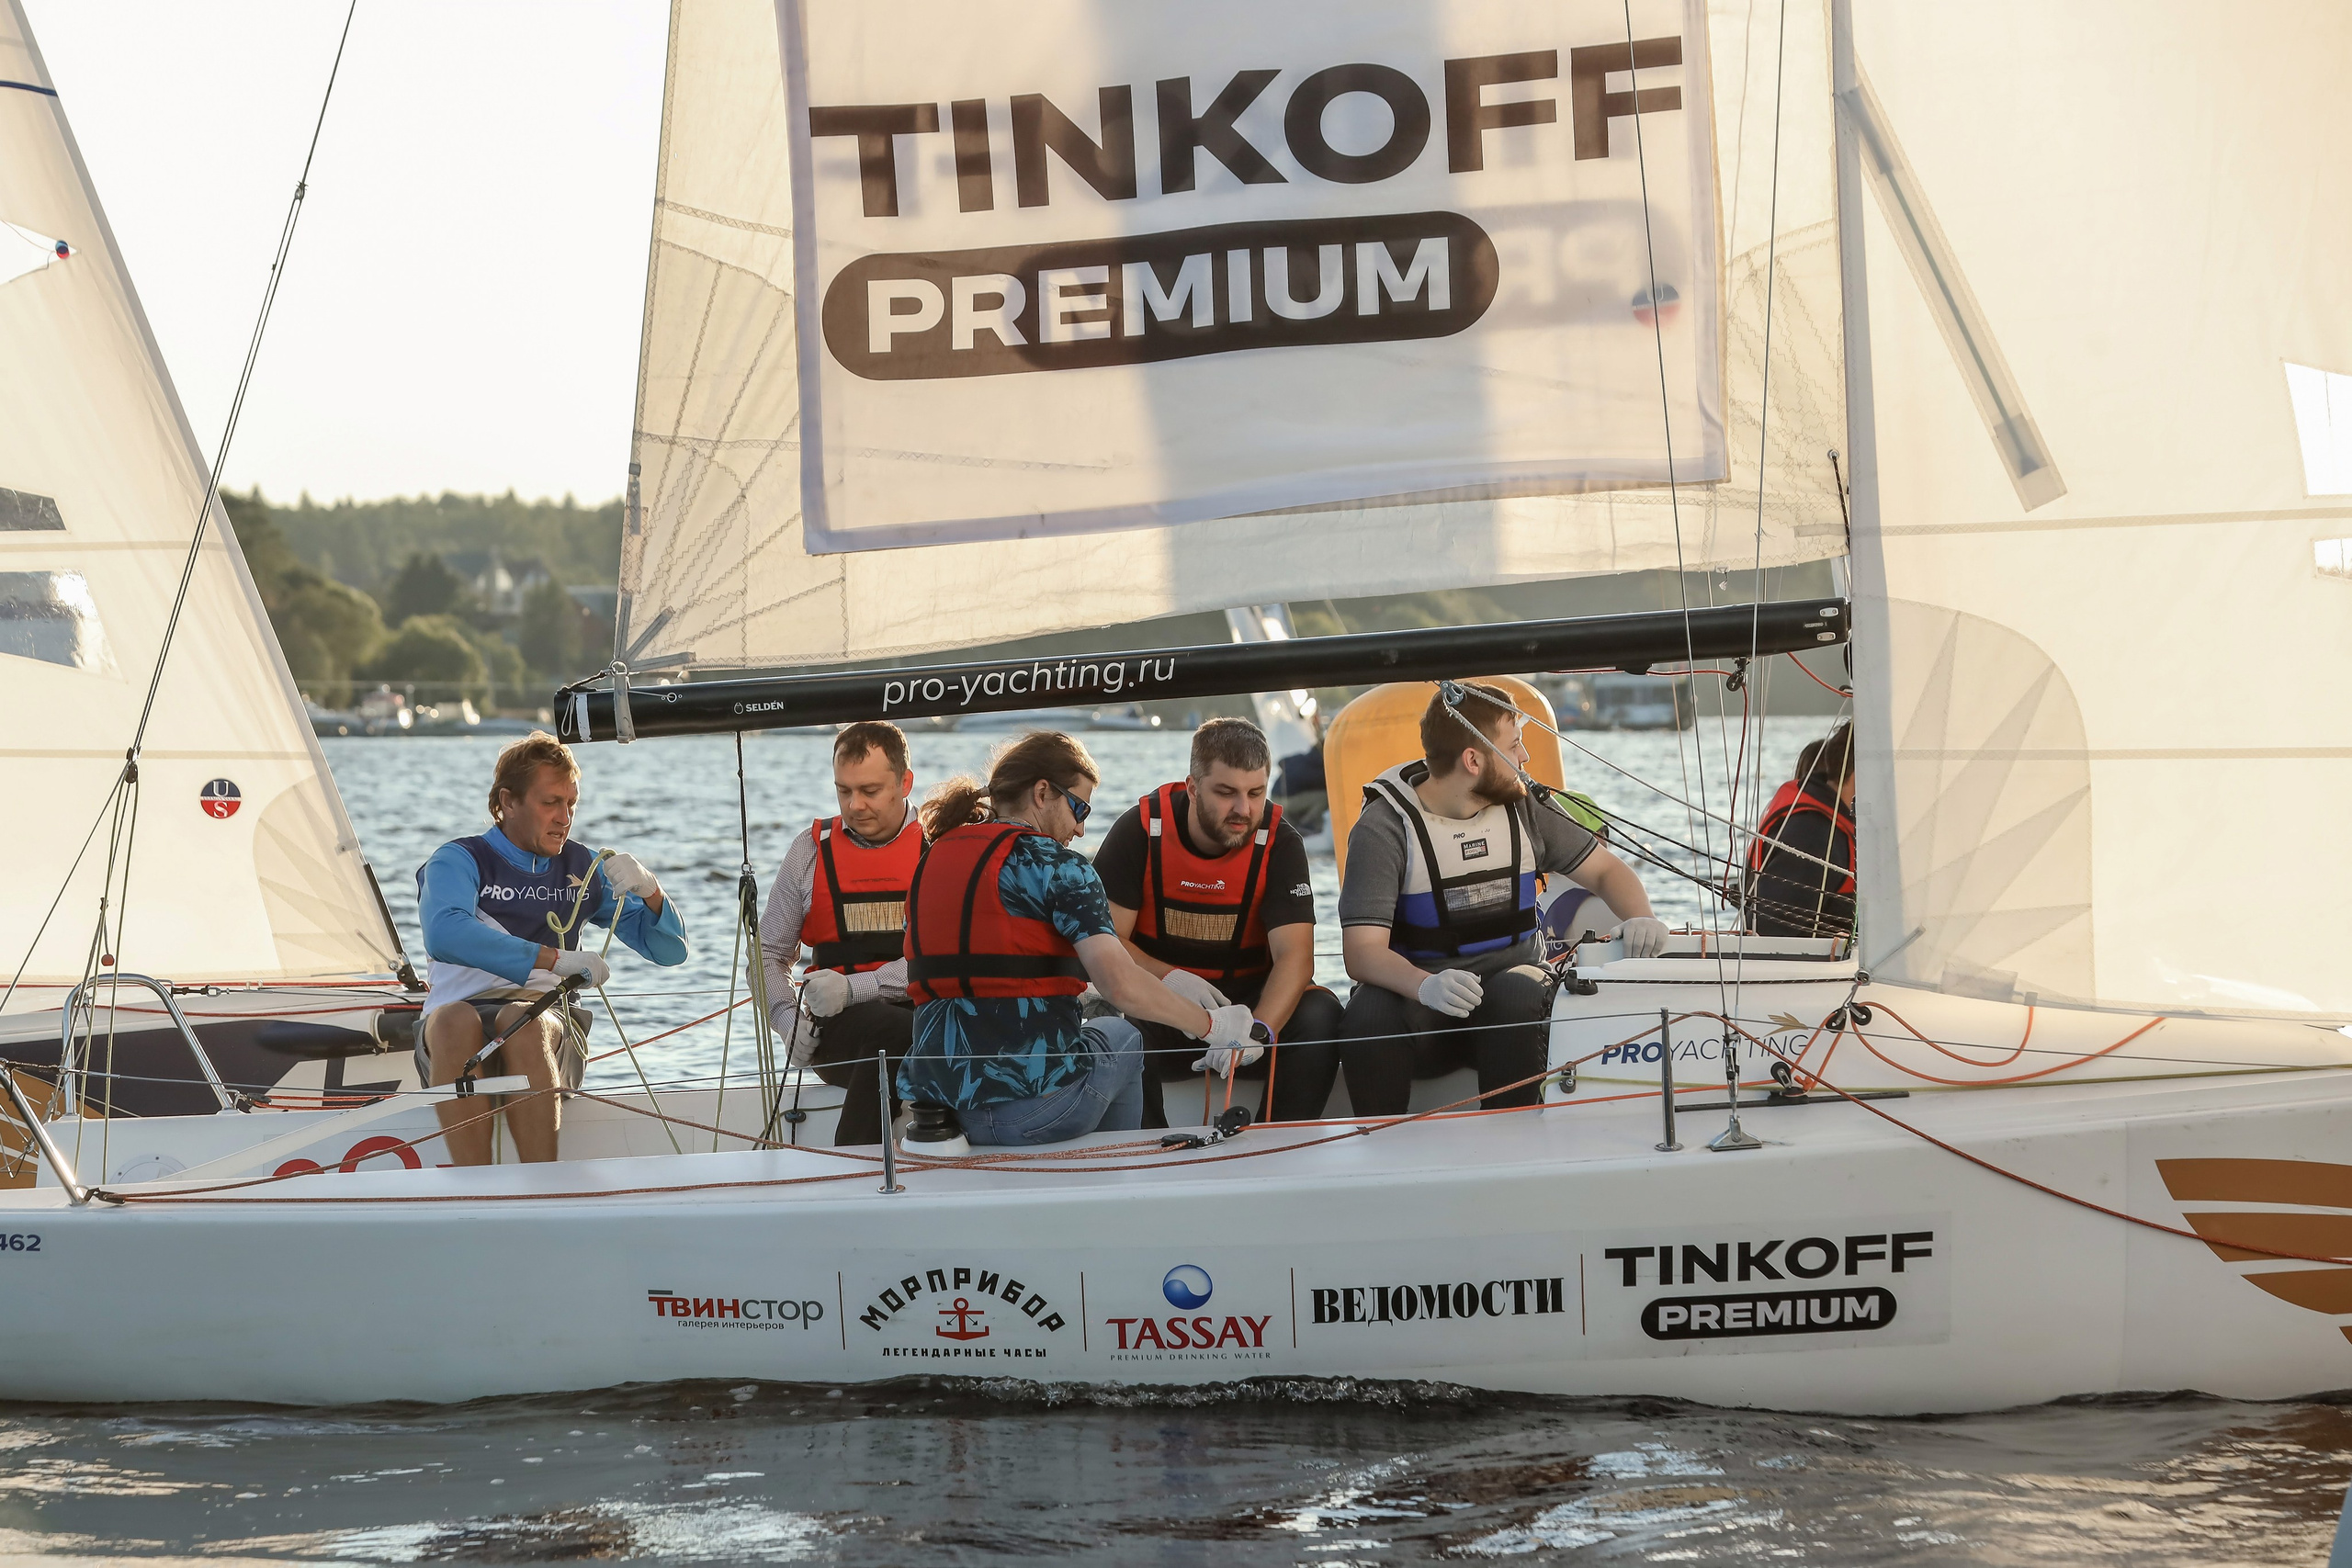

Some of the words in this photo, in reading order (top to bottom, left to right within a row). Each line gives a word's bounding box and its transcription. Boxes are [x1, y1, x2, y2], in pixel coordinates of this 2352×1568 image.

[809, 35, 1682, 219] TINKOFF
[865, 235, 1451, 355] PREMIUM
[881, 655, 1176, 713] pro-yachting.ru
[745, 700, 784, 712] SELDÉN
[480, 885, 590, 903] PROYACHTING
[1181, 880, 1226, 890] PROYACHTING
[1605, 1231, 1934, 1287] TINKOFF
[859, 1268, 1066, 1332] МОРПРИБОР
[1311, 1277, 1566, 1327] ВЕДОМОСТИ
[1658, 1294, 1880, 1332] PREMIUM
[677, 1319, 719, 1329] галерея
[721, 1321, 785, 1331] интерьеров
[1105, 1314, 1273, 1349] TASSAY
[882, 1348, 996, 1358] ЛЕГЕНДАРНЫЕ
[1003, 1348, 1046, 1358] ЧАСЫ
